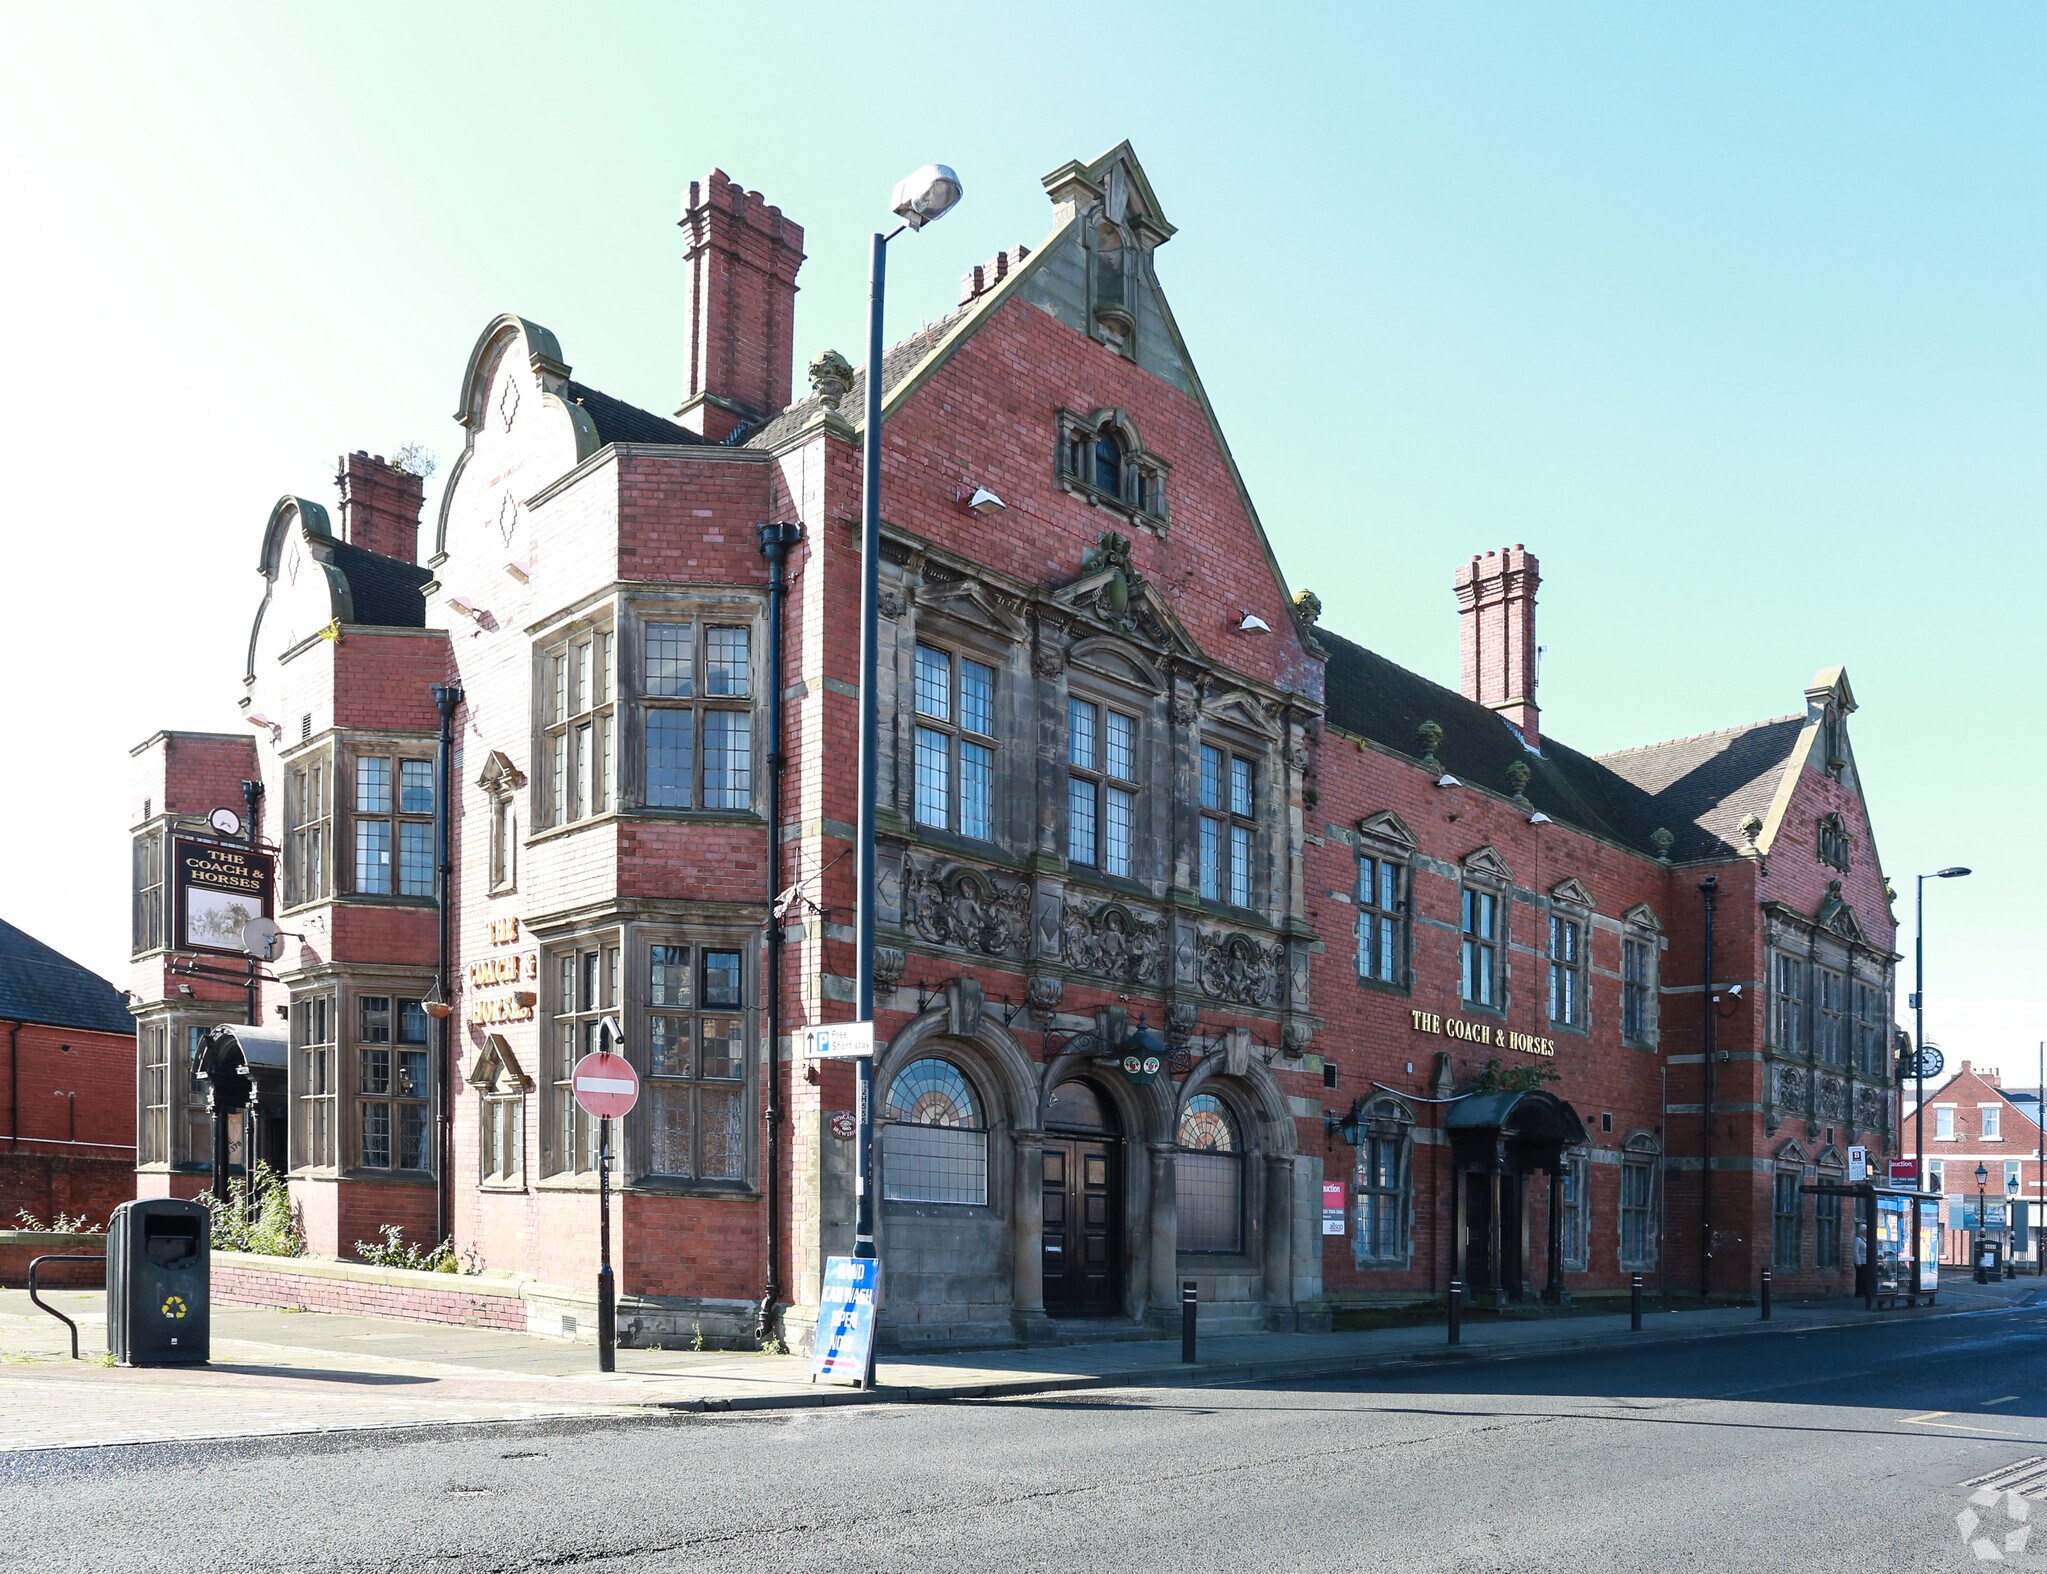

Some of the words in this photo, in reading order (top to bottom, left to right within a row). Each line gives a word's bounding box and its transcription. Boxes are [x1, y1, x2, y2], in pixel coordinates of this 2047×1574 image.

[208, 850, 244, 864] THE
[186, 858, 248, 876] COACH
[252, 869, 264, 879] &
[191, 870, 260, 889] HORSES
[487, 917, 519, 944] THE
[469, 956, 520, 986] COACH
[832, 1030, 847, 1039] Free
[1412, 1009, 1440, 1034] THE
[1446, 1018, 1490, 1044] COACH
[1495, 1029, 1505, 1048] &
[1508, 1031, 1555, 1057] HORSES
[832, 1041, 852, 1051] Short
[855, 1041, 870, 1051] stay
[838, 1263, 865, 1280] HAND
[822, 1285, 843, 1303] CAR
[844, 1286, 874, 1305] WASH
[831, 1310, 859, 1328] OPEN
[829, 1335, 855, 1351] NOW
